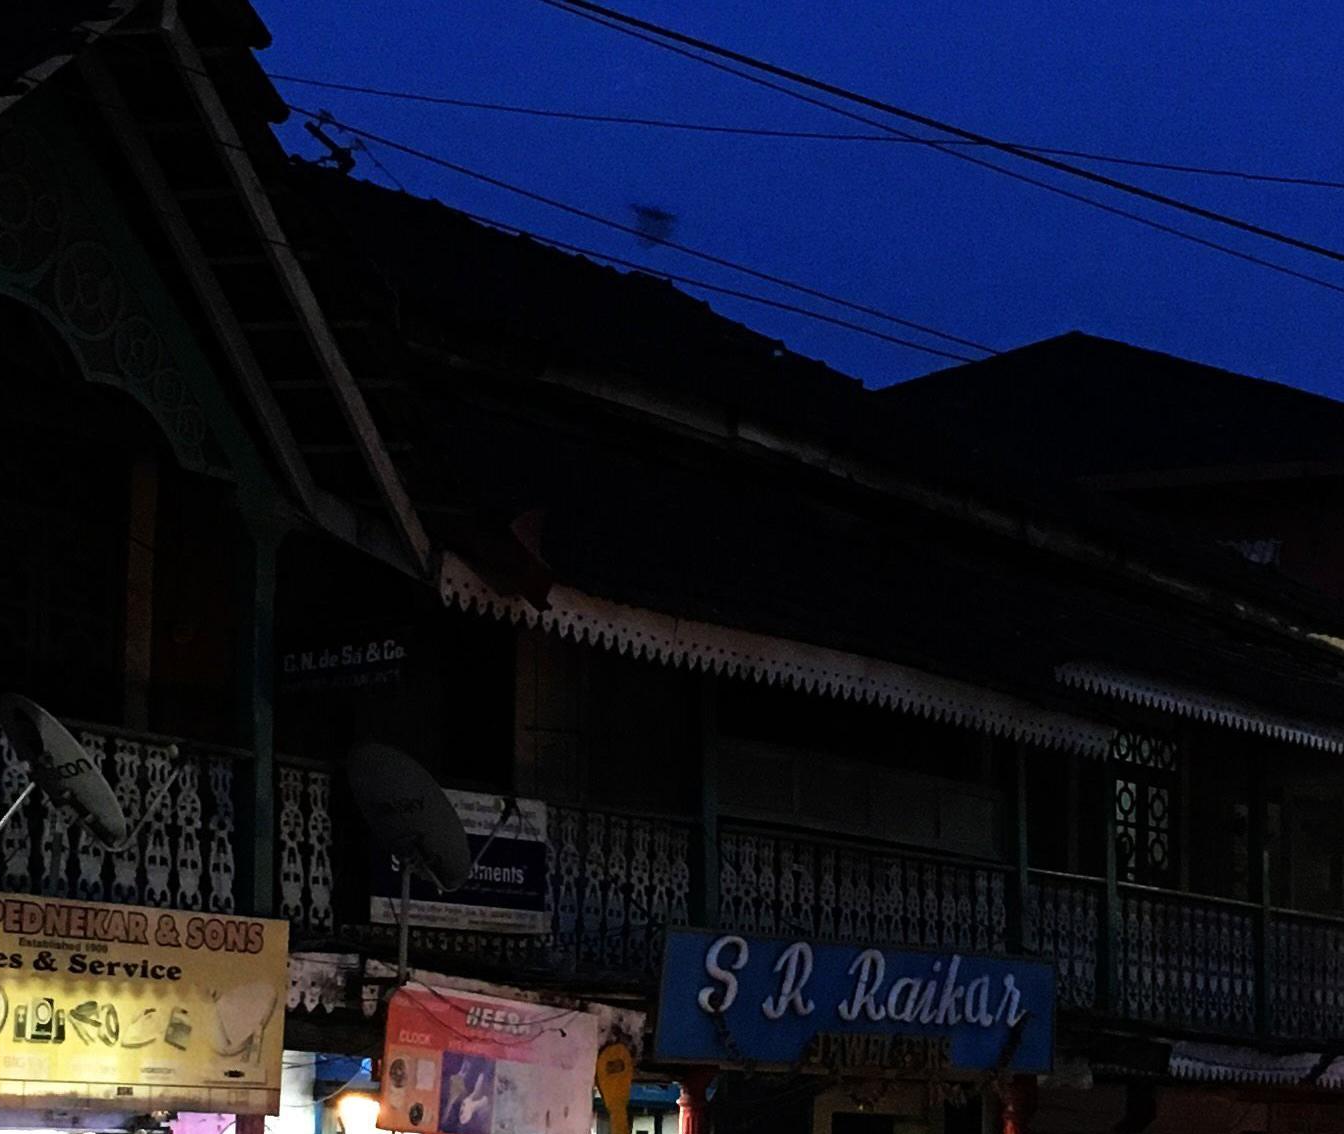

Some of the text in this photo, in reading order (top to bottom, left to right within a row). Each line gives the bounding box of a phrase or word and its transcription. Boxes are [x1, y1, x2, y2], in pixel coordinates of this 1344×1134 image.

[366, 641, 380, 662] &
[156, 914, 181, 947] &
[186, 917, 264, 954] SONS
[33, 951, 58, 972] &
[68, 953, 182, 981] Service
[697, 935, 1030, 1028] S R Raikar
